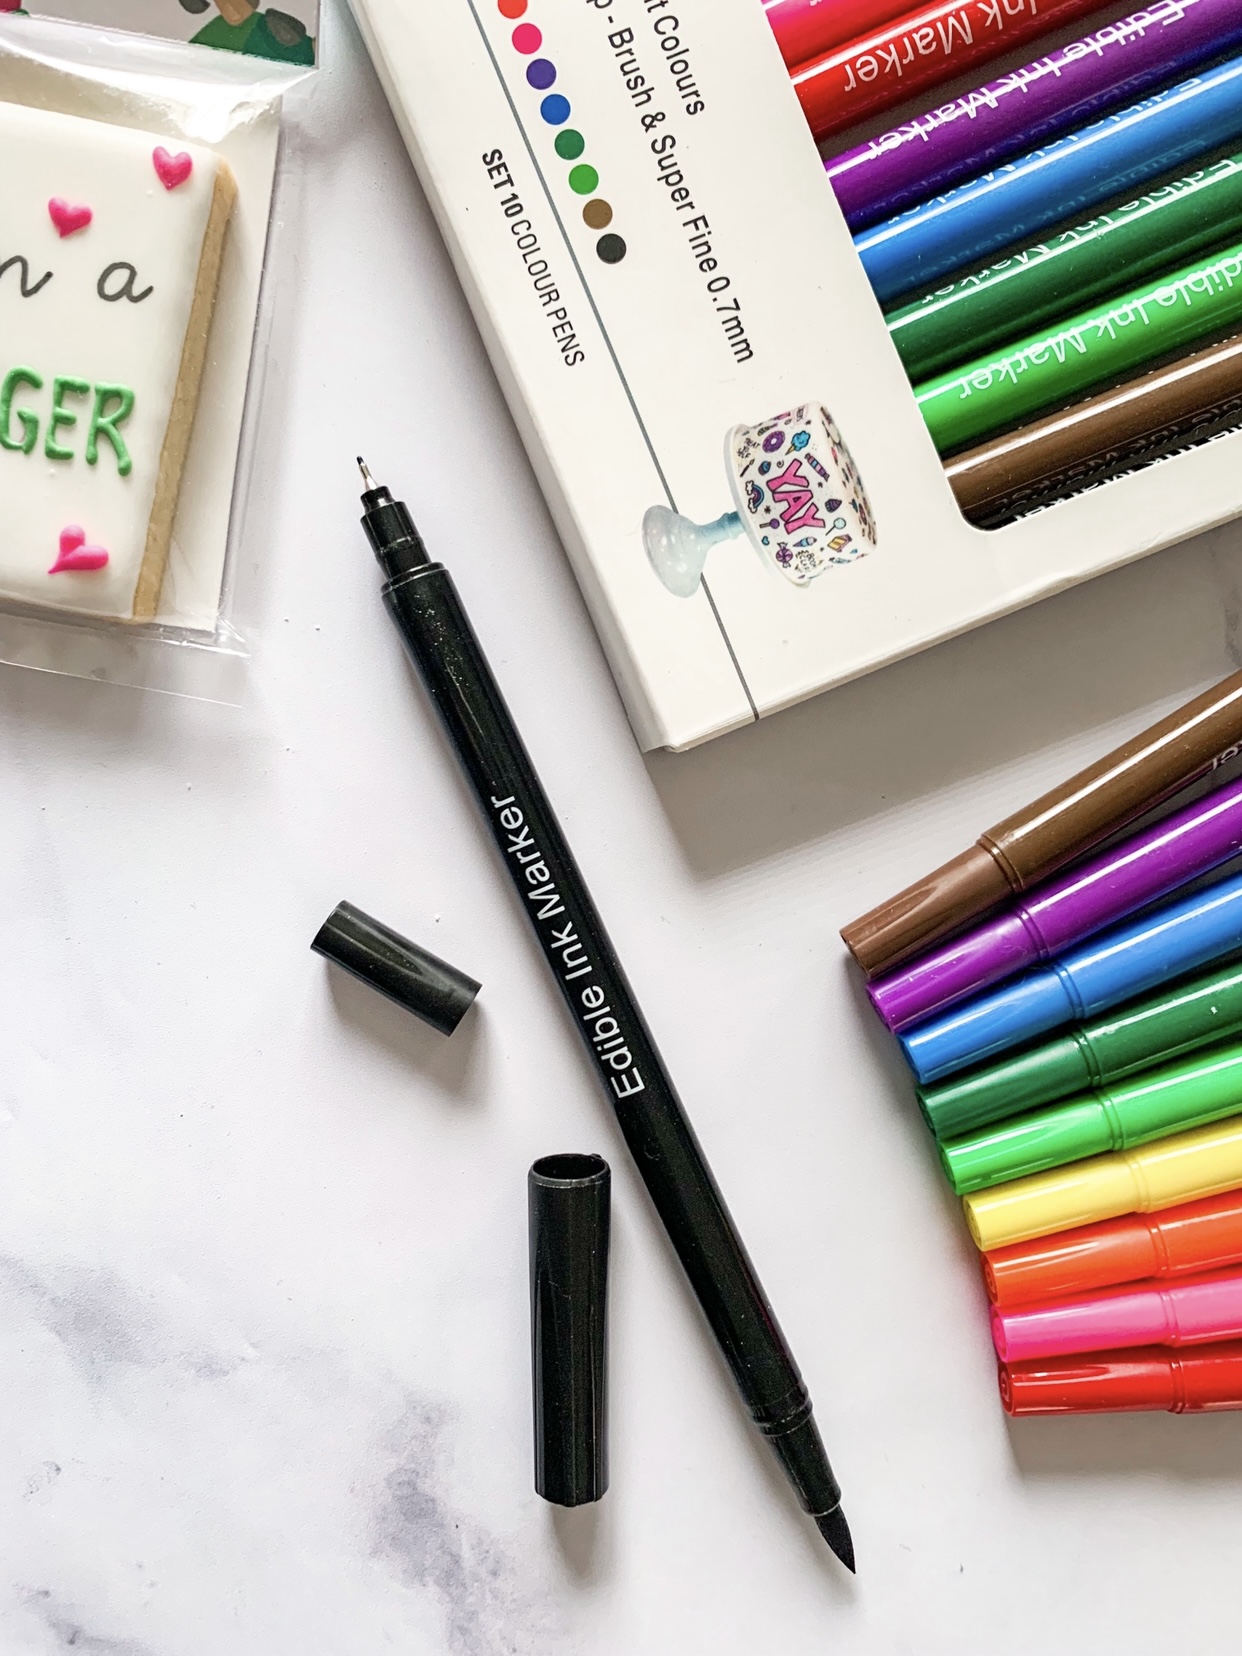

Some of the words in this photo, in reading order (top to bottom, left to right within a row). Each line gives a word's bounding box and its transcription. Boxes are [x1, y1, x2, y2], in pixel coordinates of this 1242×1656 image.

[844, 9, 975, 93] Marker
[1063, 0, 1186, 60] Edible
[608, 27, 655, 108] Brush
[653, 15, 705, 116] Colours
[996, 57, 1062, 95] Ink
[640, 111, 666, 133] &
[867, 88, 999, 160] Marker
[481, 148, 515, 190] SET
[651, 134, 696, 211] Super
[500, 192, 524, 218] 10
[510, 219, 560, 307] COLOUR
[682, 214, 718, 273] Fine
[96, 261, 154, 304] a
[1152, 256, 1242, 307] dible
[546, 306, 585, 367] PENS
[706, 276, 754, 364] 0.7mm
[1096, 303, 1150, 340] Ink
[958, 332, 1088, 400] Marker
[766, 457, 827, 536] YAY
[490, 795, 566, 920] Marker
[550, 920, 593, 981] Ink
[581, 985, 647, 1099] Edible
